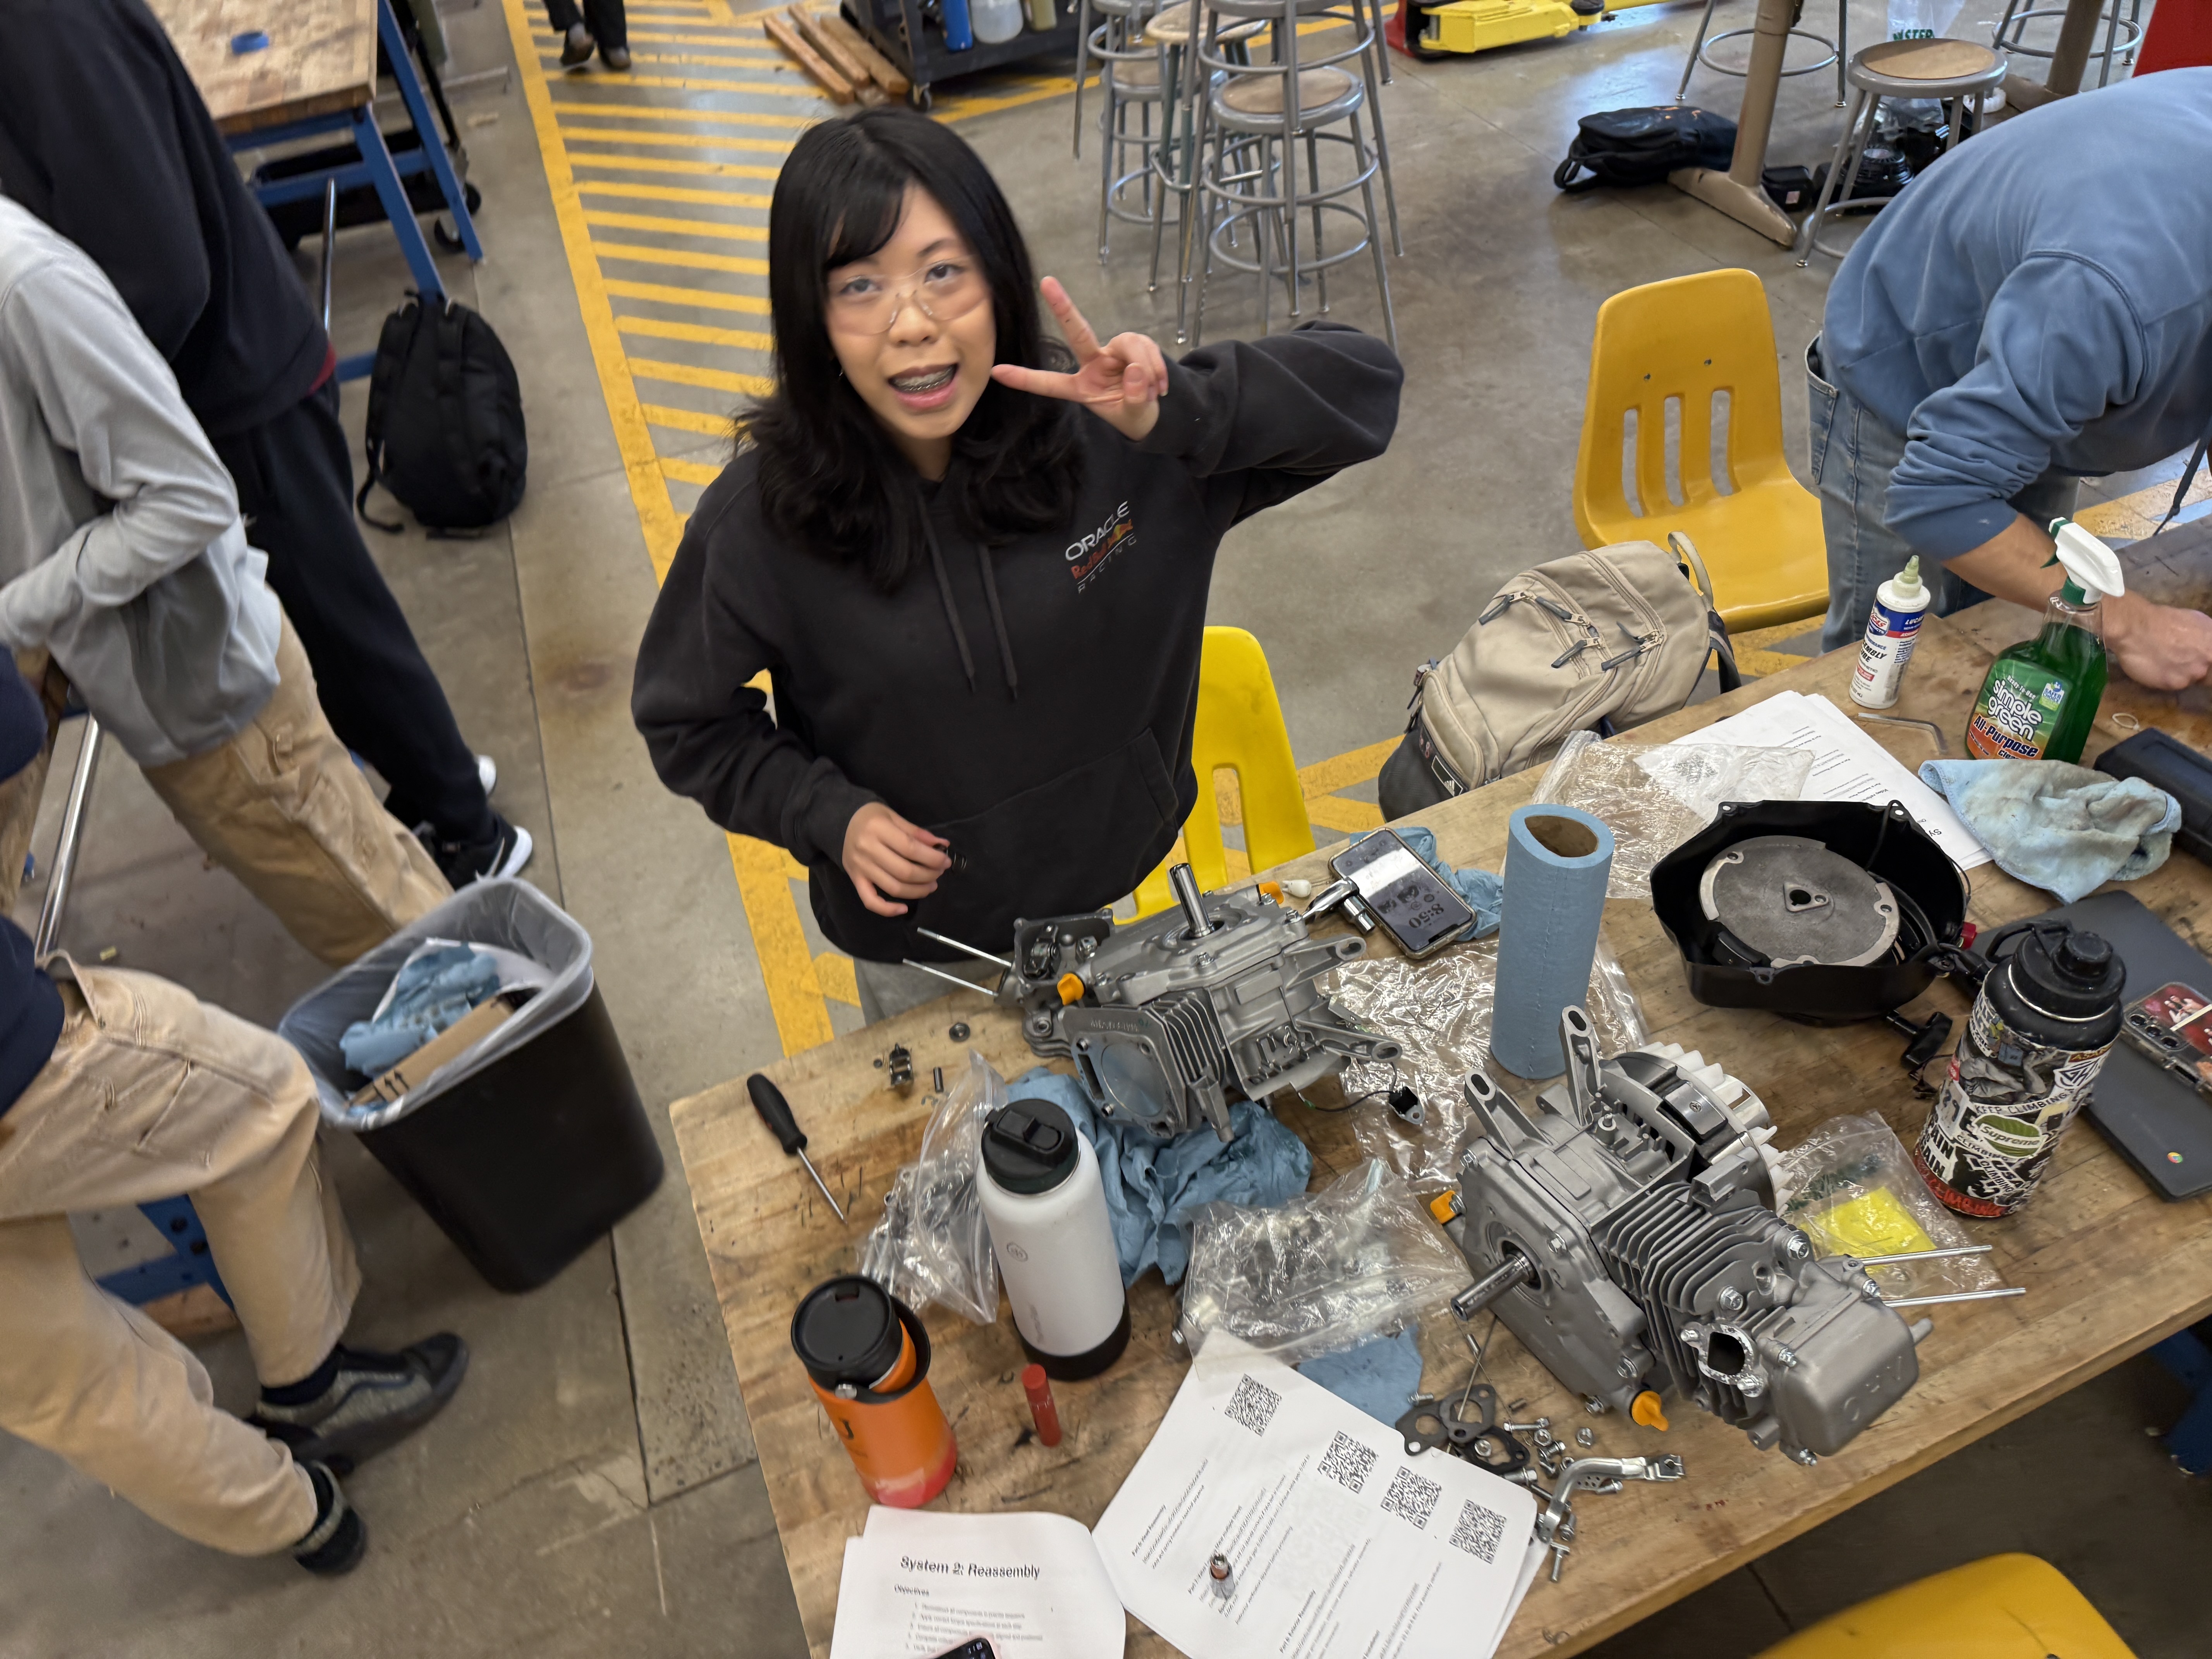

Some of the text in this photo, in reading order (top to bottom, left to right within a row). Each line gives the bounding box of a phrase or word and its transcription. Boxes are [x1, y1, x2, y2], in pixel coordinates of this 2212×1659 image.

[1065, 500, 1130, 561] ORACLE
[1077, 535, 1137, 595] RACING
[1988, 696, 2034, 742] green
[1993, 679, 2043, 725] simple
[1974, 715, 2039, 757] All-Purpose
[1408, 903, 1444, 928] 8:50
[1975, 1092, 2068, 1115] KEEP CLIMBING
[1980, 1126, 2040, 1145] Supreme
[1980, 1160, 2014, 1193] CLIMBING
[900, 1555, 949, 1574] System
[968, 1563, 1040, 1581] Reassembly
